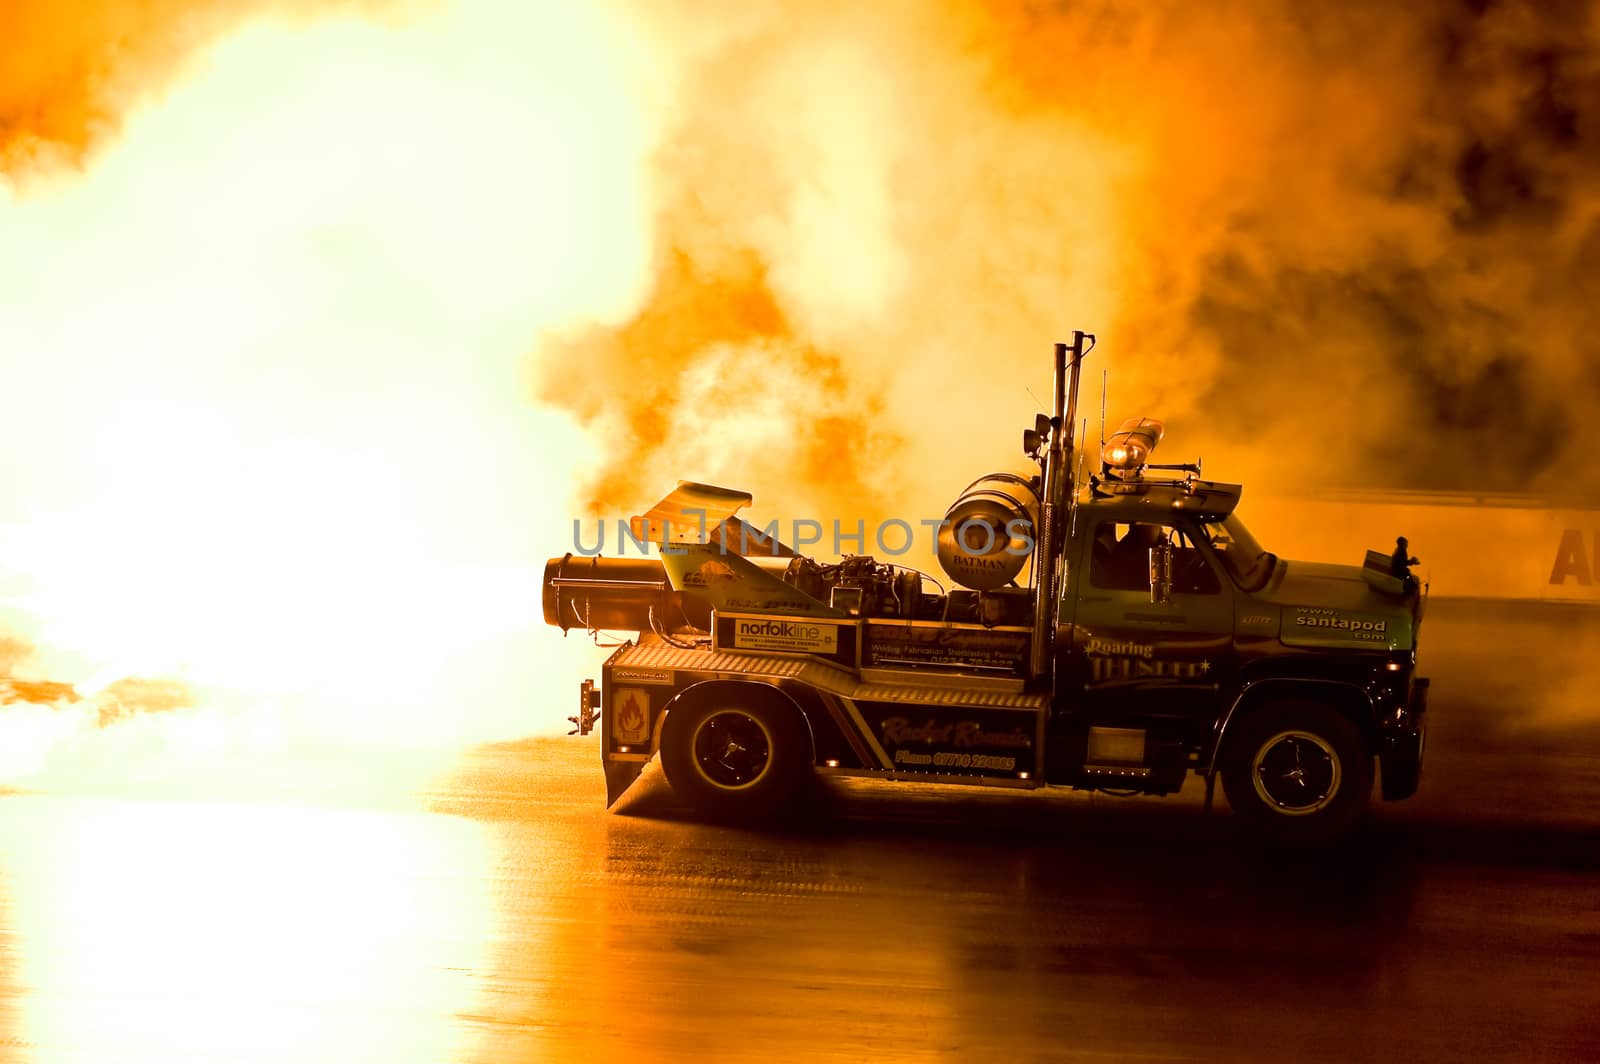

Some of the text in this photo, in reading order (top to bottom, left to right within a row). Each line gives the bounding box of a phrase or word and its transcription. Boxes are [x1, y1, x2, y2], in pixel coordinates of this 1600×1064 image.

[953, 555, 1005, 569] BATMAN
[1548, 528, 1600, 586] A
[740, 621, 820, 639] norfolkline
[1296, 616, 1386, 632] santapod
